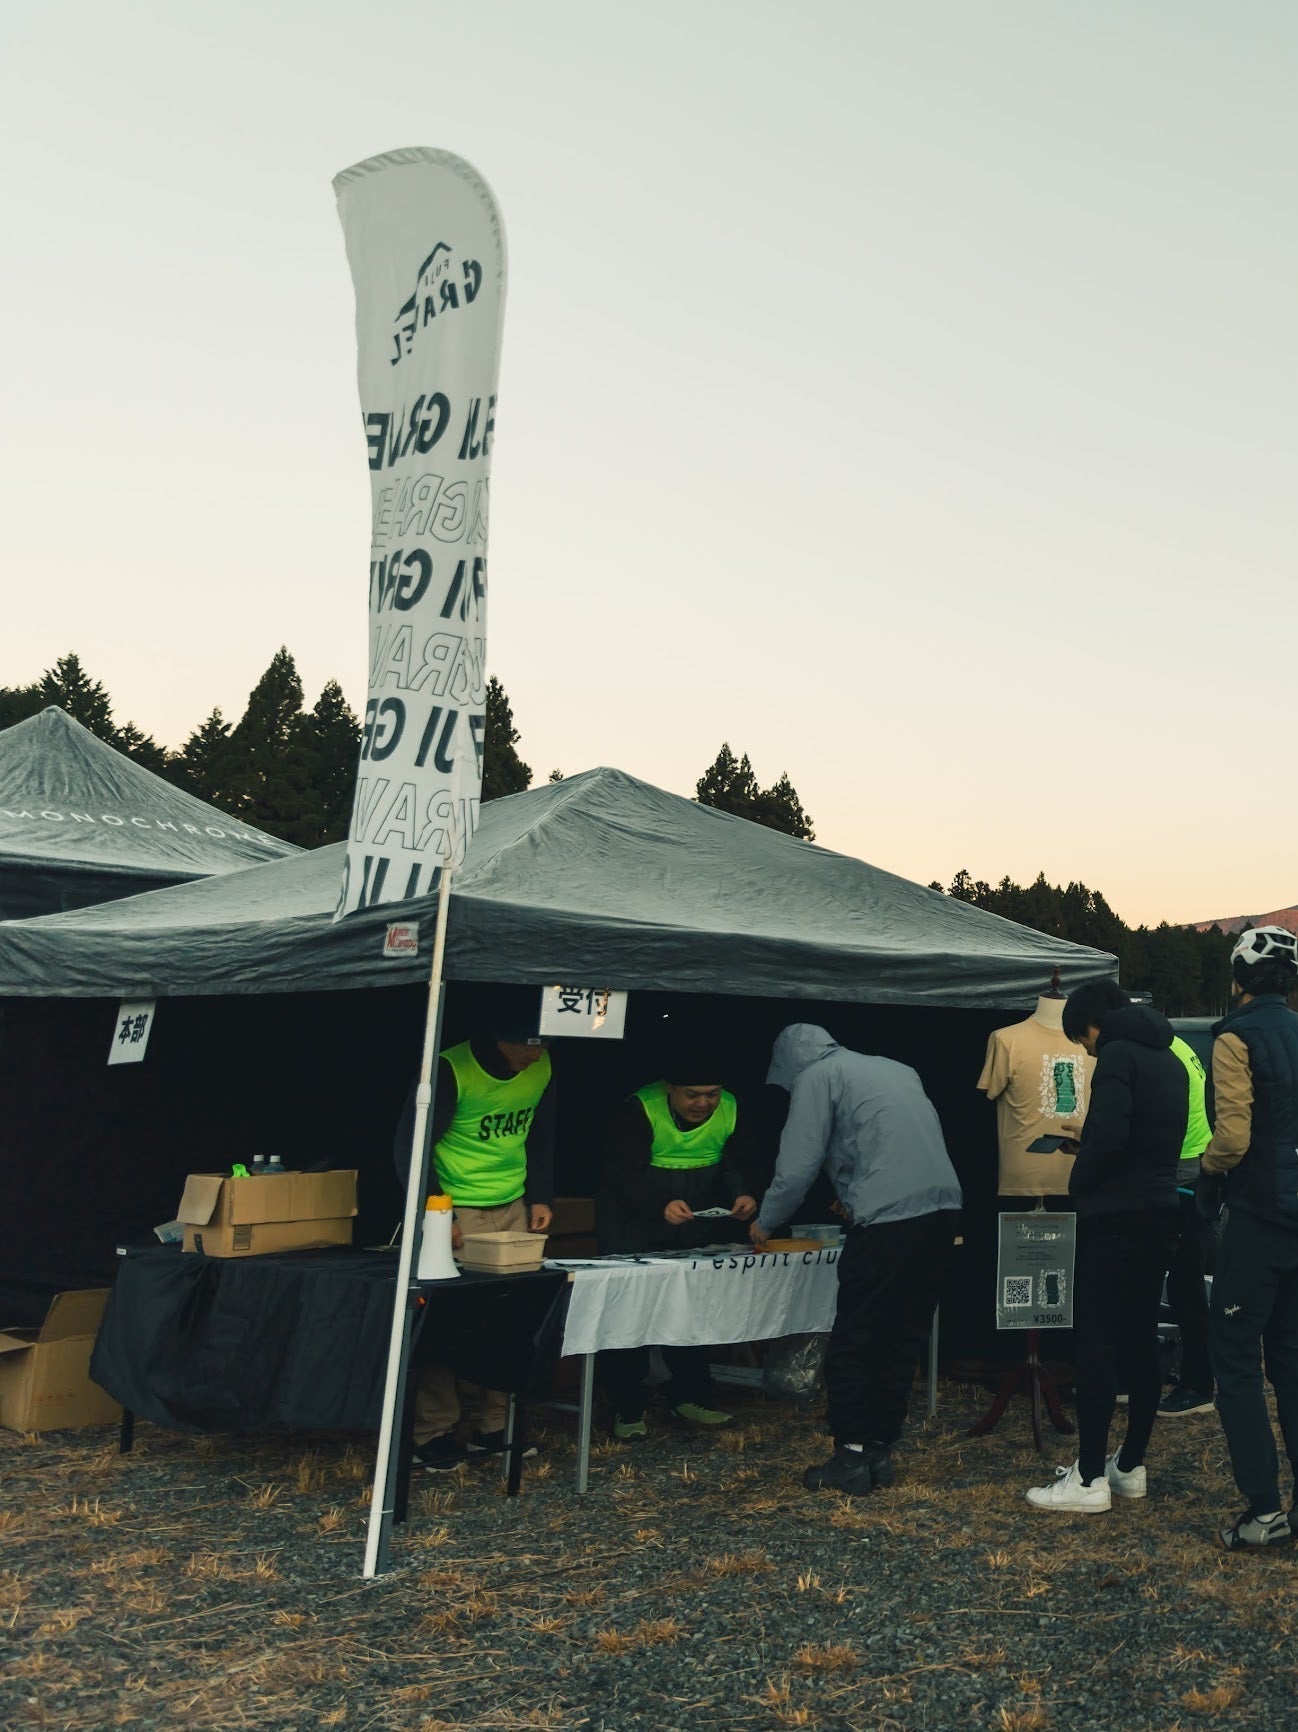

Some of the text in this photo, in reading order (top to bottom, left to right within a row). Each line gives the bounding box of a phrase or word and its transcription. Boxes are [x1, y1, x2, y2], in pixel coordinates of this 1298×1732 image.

[4, 810, 276, 846] MONOCHROME
[557, 985, 611, 1016] 受付
[119, 1013, 148, 1044] 本部
[479, 1106, 533, 1141] STAFF
[802, 1250, 839, 1266] clu
